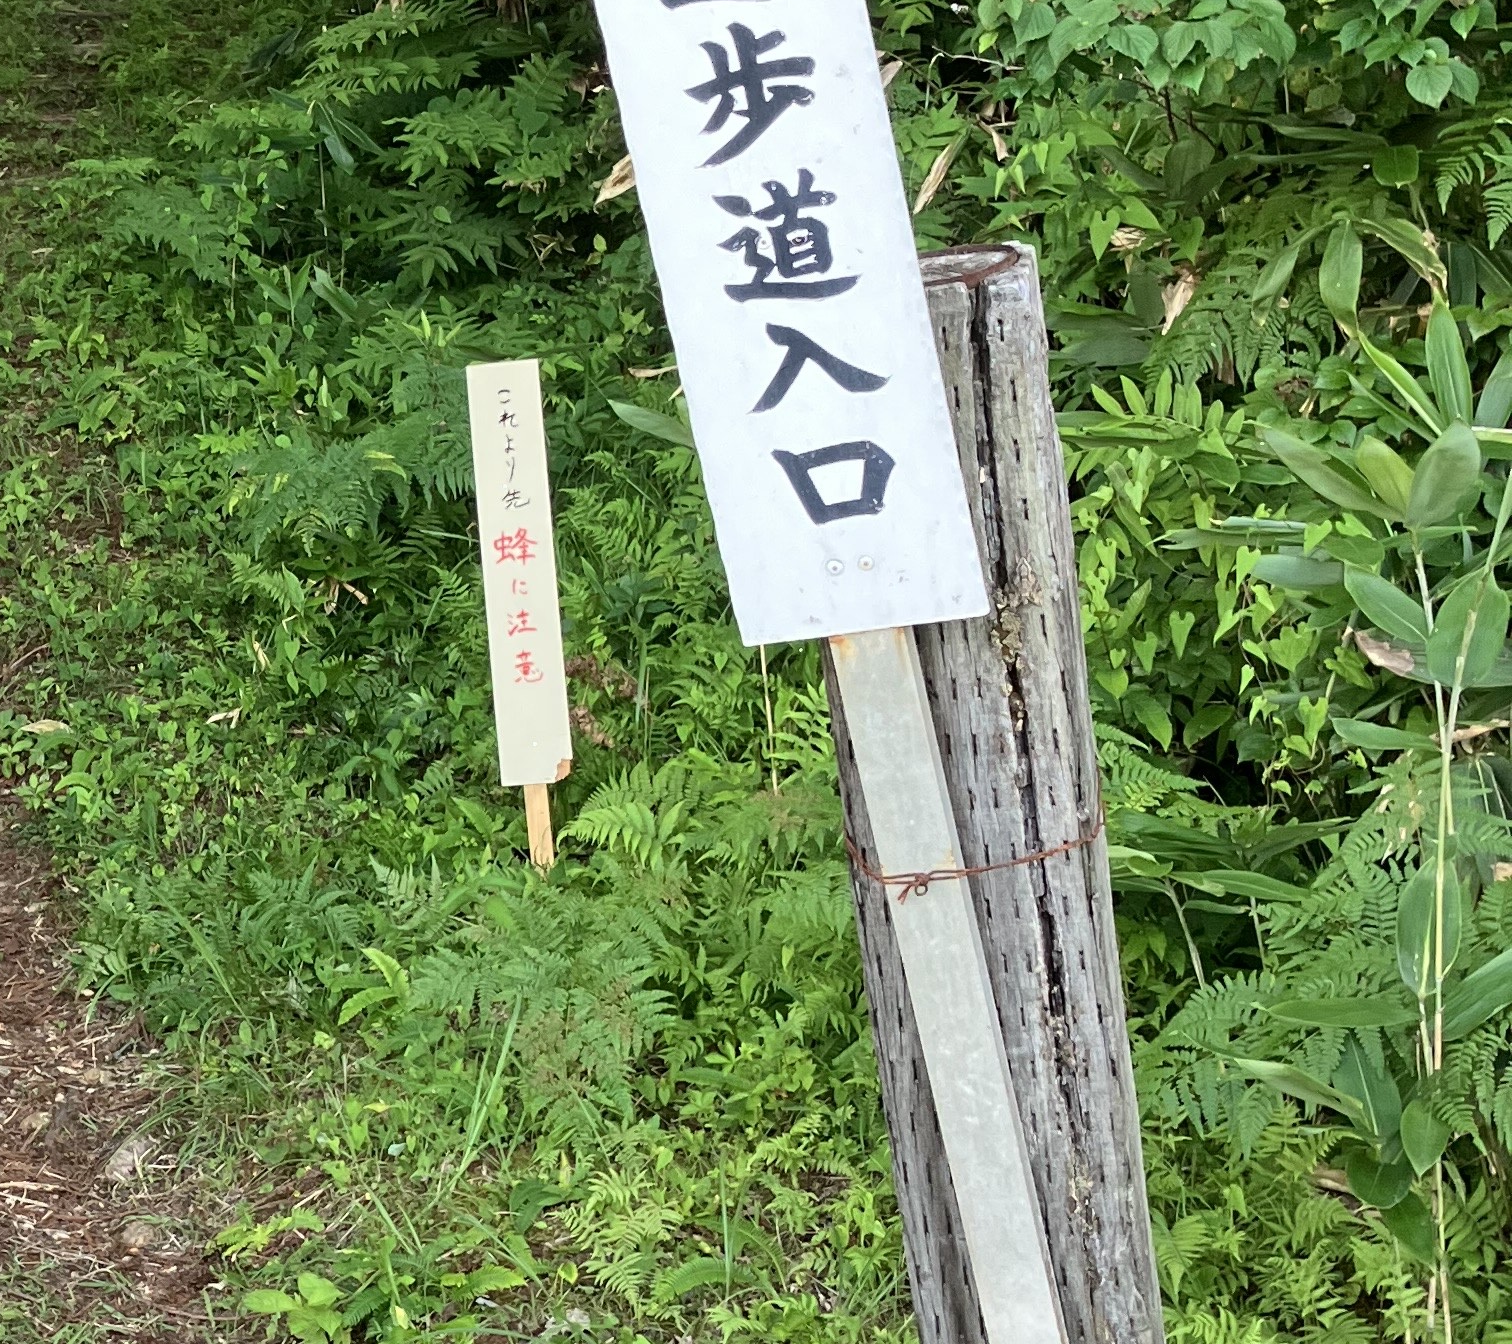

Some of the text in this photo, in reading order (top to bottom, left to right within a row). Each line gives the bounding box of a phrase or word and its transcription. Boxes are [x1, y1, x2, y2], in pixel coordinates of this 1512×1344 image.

[493, 389, 544, 683] これより先 蜂に注意
